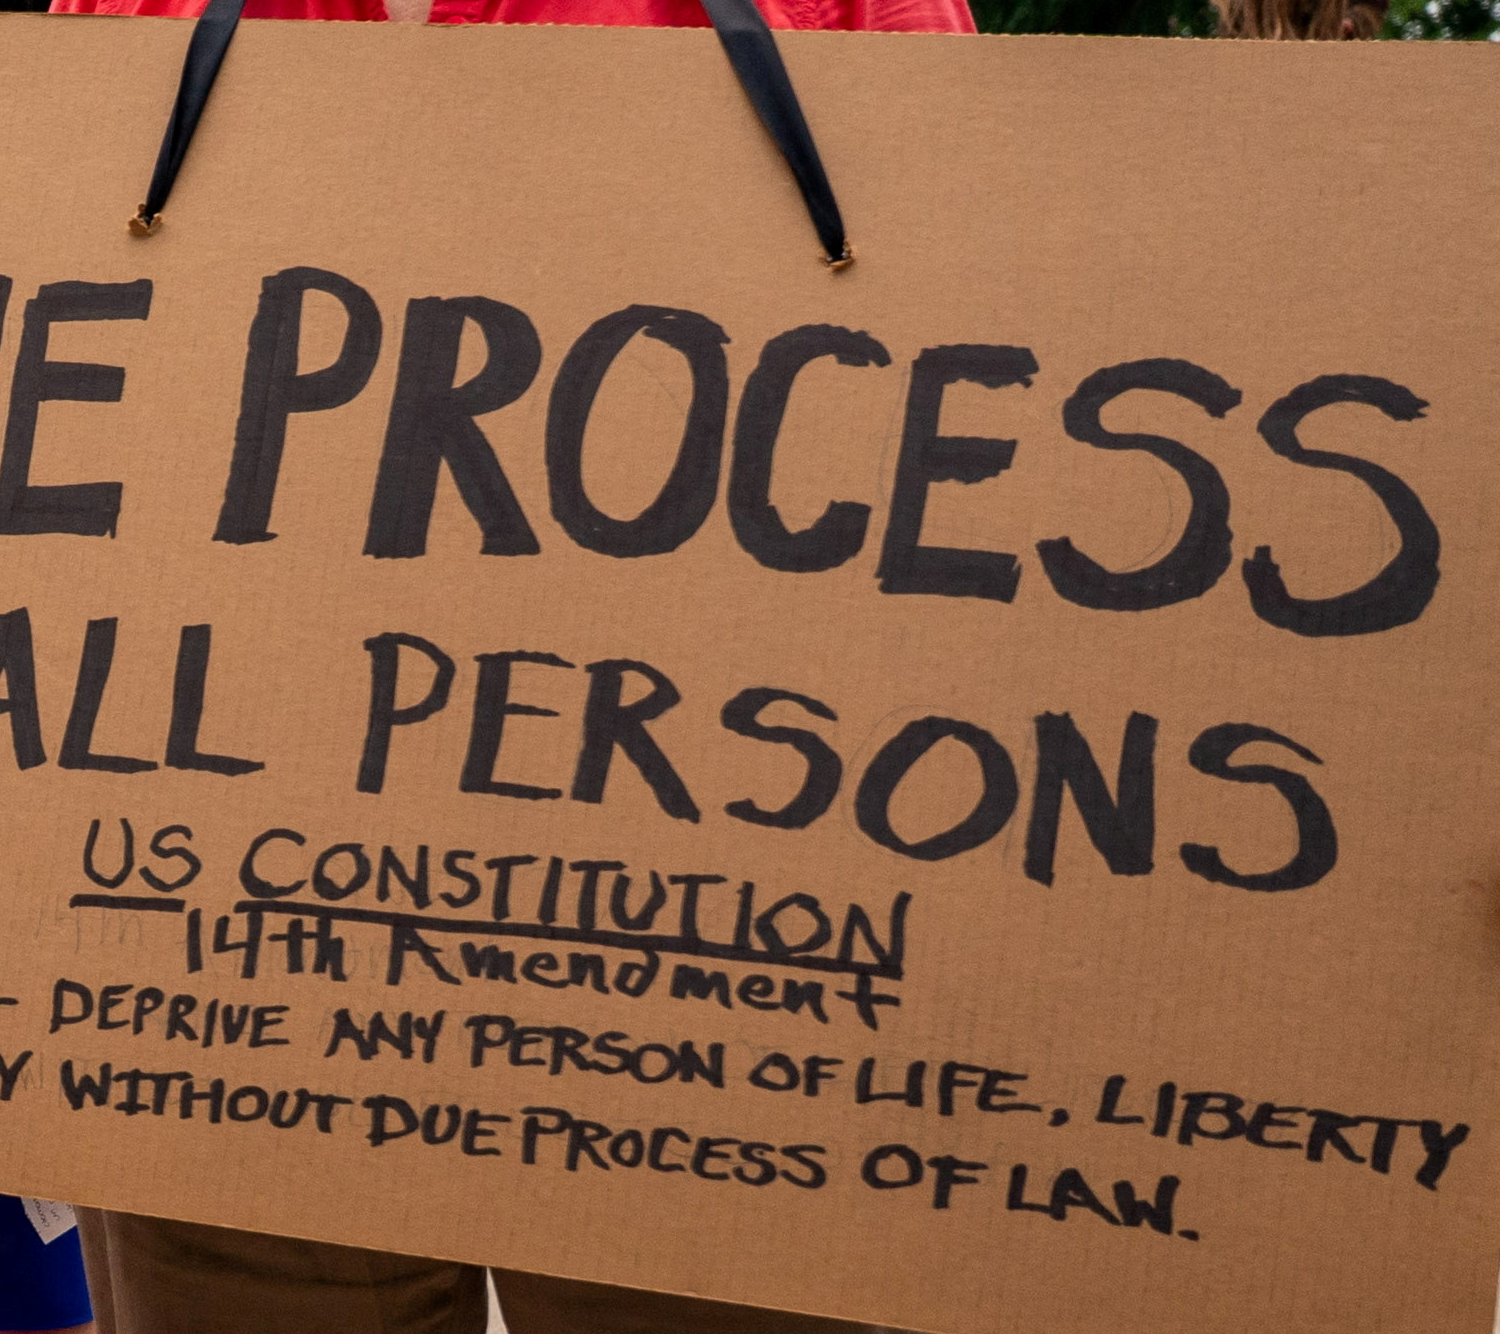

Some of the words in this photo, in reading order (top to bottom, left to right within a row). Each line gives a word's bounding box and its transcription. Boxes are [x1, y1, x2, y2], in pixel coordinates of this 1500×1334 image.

[211, 268, 1441, 637] PROCESS
[356, 630, 1338, 892] PERSONS
[83, 818, 203, 893] US
[238, 829, 911, 972] CONSTITUTION
[49, 979, 291, 1048] DEPRIVE
[327, 1008, 446, 1067] ANY
[466, 1014, 724, 1088] PERSON
[748, 1053, 837, 1096] OF
[854, 1057, 1072, 1128] LIFE,
[1097, 1075, 1470, 1191] LIBERTY
[59, 1059, 361, 1135] WITHOUT
[364, 1093, 503, 1157] DUE
[520, 1105, 829, 1189] PROCESS
[860, 1143, 988, 1210] OF
[1006, 1162, 1200, 1242] LAW.
